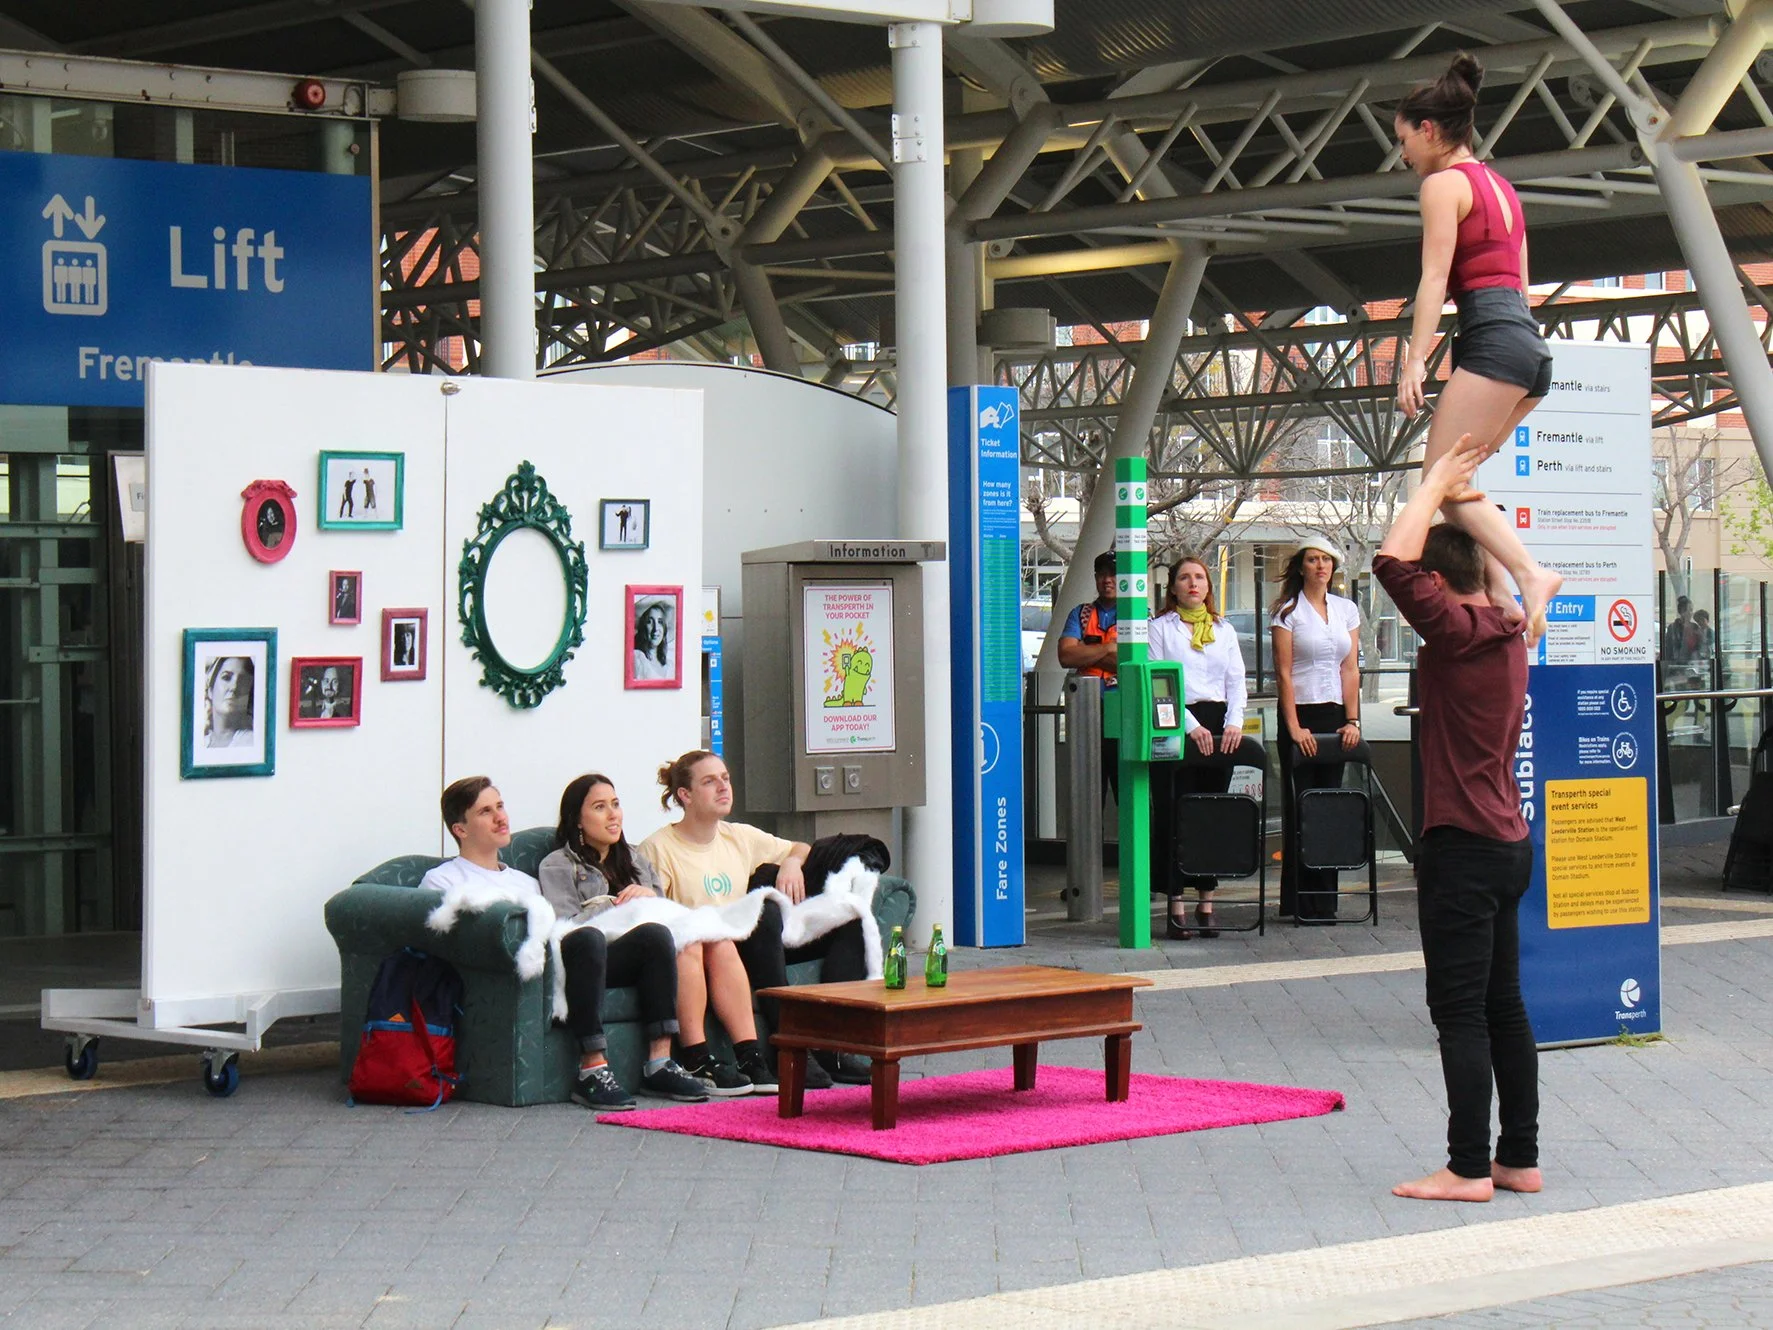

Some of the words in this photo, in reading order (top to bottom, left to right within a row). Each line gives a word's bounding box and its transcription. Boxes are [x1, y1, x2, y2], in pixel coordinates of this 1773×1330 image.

[170, 226, 285, 293] Lift
[1549, 380, 1582, 391] mantle
[1594, 384, 1610, 392] stairs
[980, 438, 1000, 446] Ticket
[1537, 431, 1583, 443] Fremantle
[981, 450, 1017, 458] Information
[1538, 460, 1562, 471] Perth
[1596, 465, 1612, 473] stairs
[996, 482, 1011, 490] many
[1538, 508, 1552, 516] Train
[1553, 509, 1584, 517] replacement
[830, 544, 906, 558] Information
[825, 594, 837, 602] THE
[838, 594, 862, 602] POWER
[863, 594, 872, 602] OF
[1556, 602, 1584, 616] Entry
[1600, 646, 1611, 654] NO
[1614, 646, 1646, 654] SMOKING
[824, 714, 862, 722] DOWNLOAD
[863, 714, 877, 722] OUR
[1551, 790, 1586, 799] Transperth
[1588, 788, 1611, 798] special
[1551, 803, 1569, 811] event
[1571, 802, 1598, 810] services
[996, 796, 1006, 853] Zones
[996, 860, 1008, 900] Fare
[1614, 1009, 1647, 1020] Transperth
